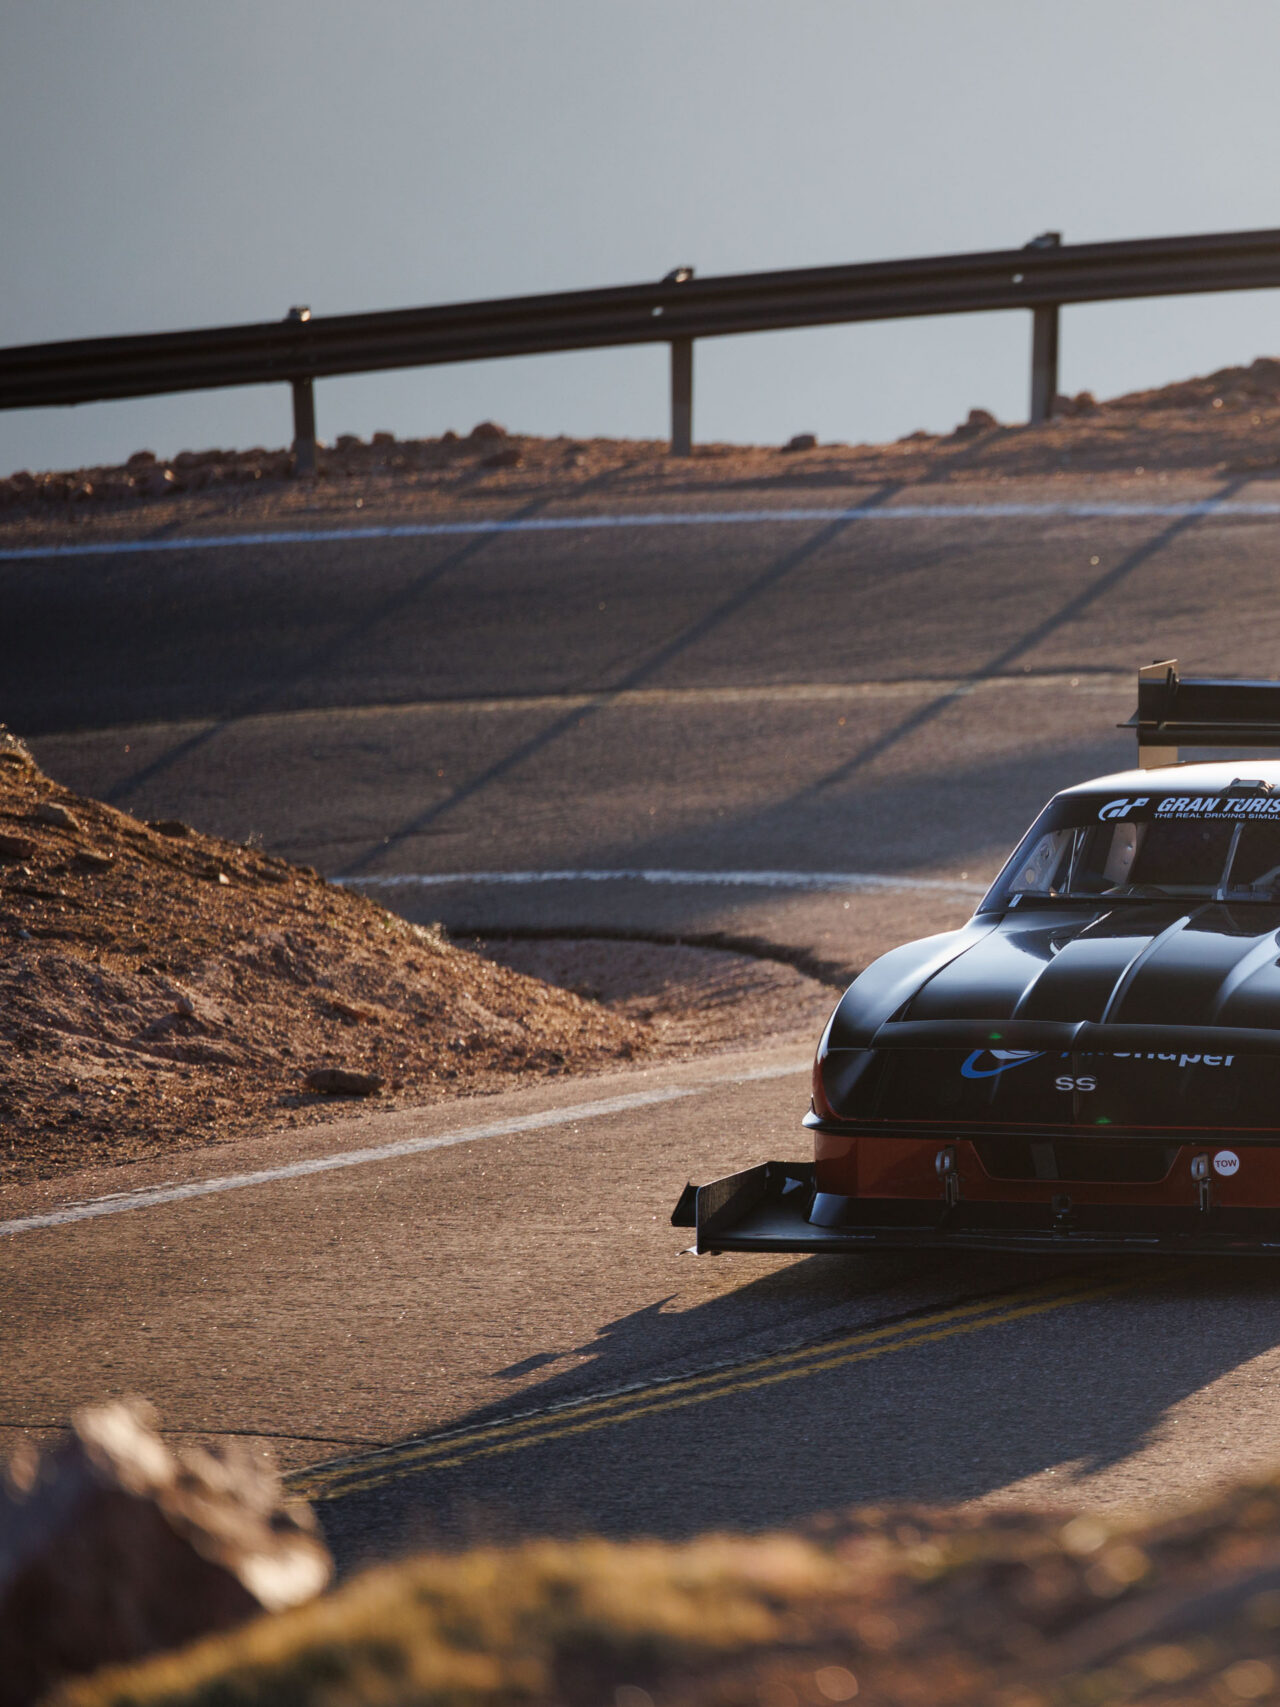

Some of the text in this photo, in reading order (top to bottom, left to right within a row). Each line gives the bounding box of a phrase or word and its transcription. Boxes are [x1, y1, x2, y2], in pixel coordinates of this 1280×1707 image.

[1157, 797, 1221, 812] GRAN
[1204, 812, 1246, 820] DRIVING
[1055, 1076, 1097, 1092] SS
[1215, 1159, 1237, 1168] TOW
